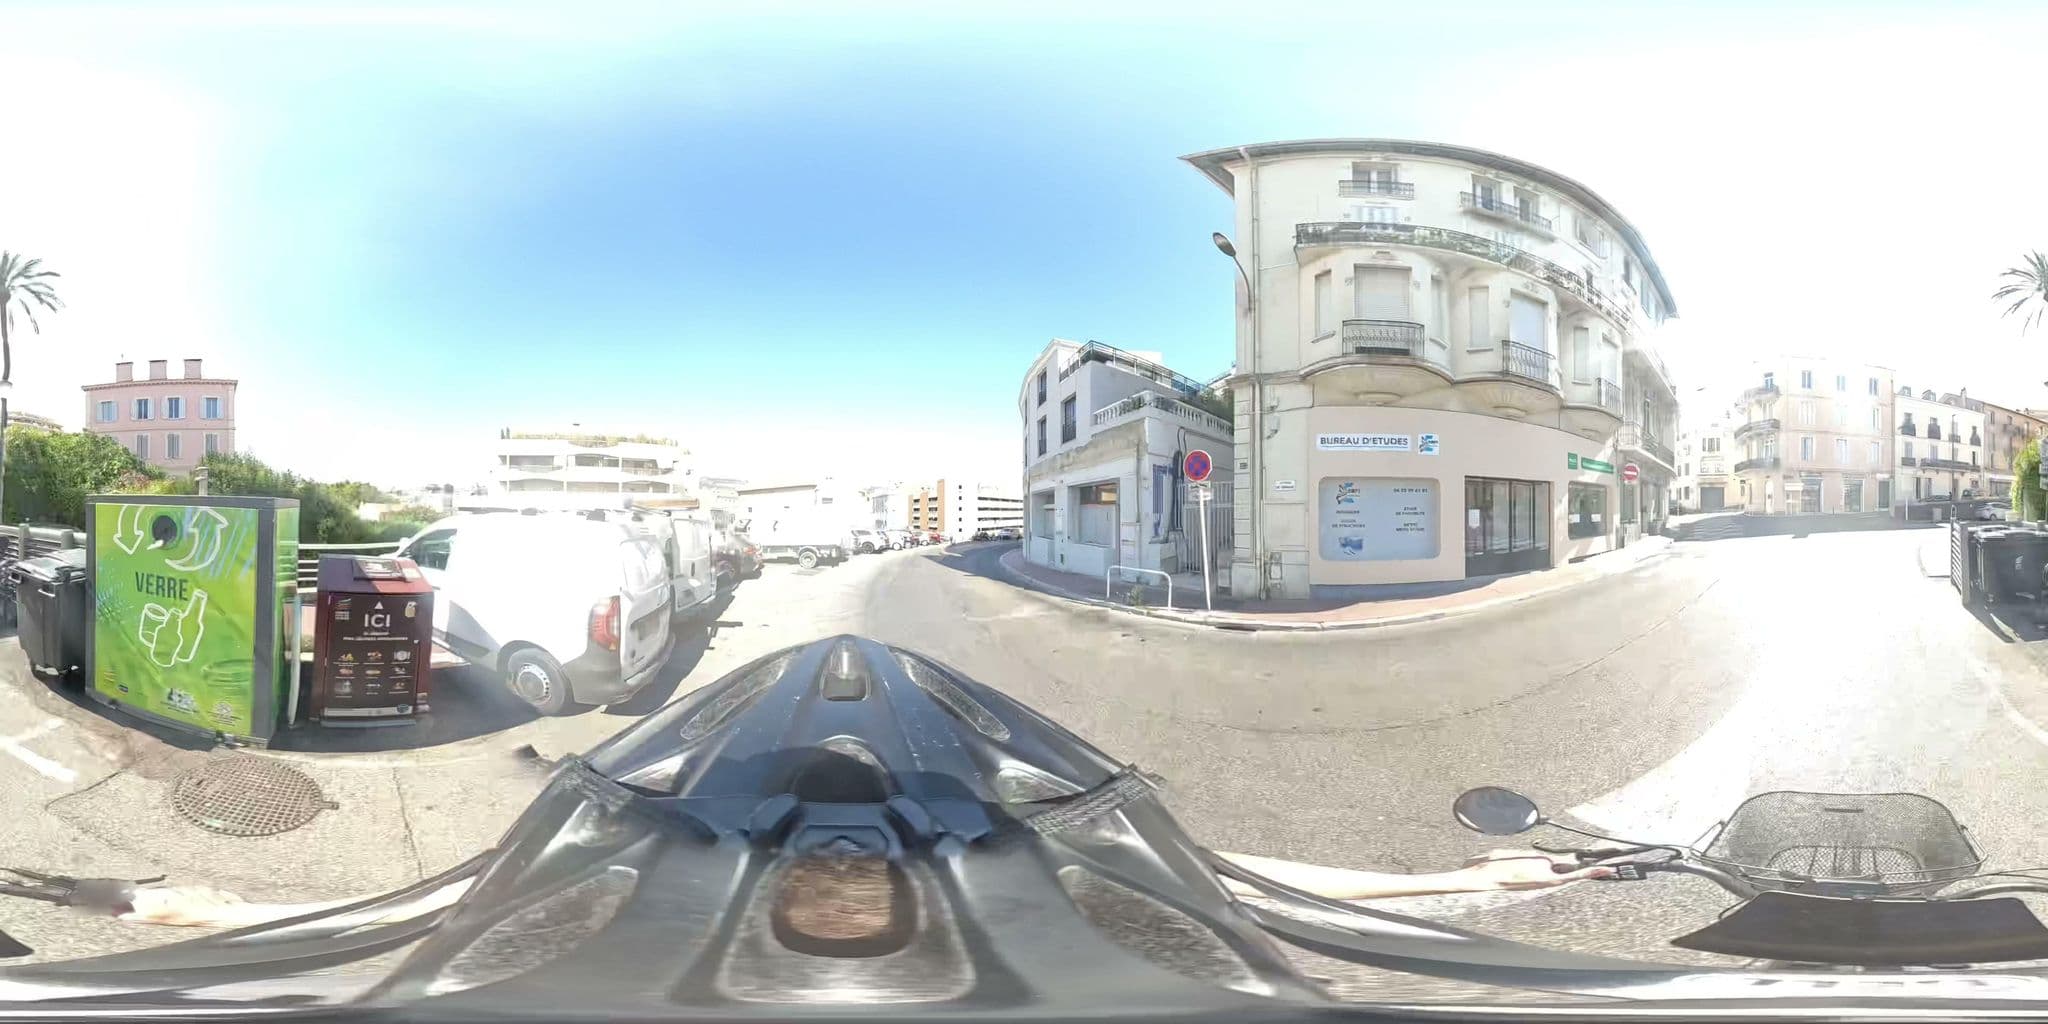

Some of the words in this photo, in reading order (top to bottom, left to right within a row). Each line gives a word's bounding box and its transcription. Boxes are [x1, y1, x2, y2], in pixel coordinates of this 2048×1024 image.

[1320, 436, 1360, 446] BUREAU
[1362, 436, 1409, 446] D'ETUDES
[135, 571, 189, 602] VERRE
[364, 613, 391, 628] ICI
